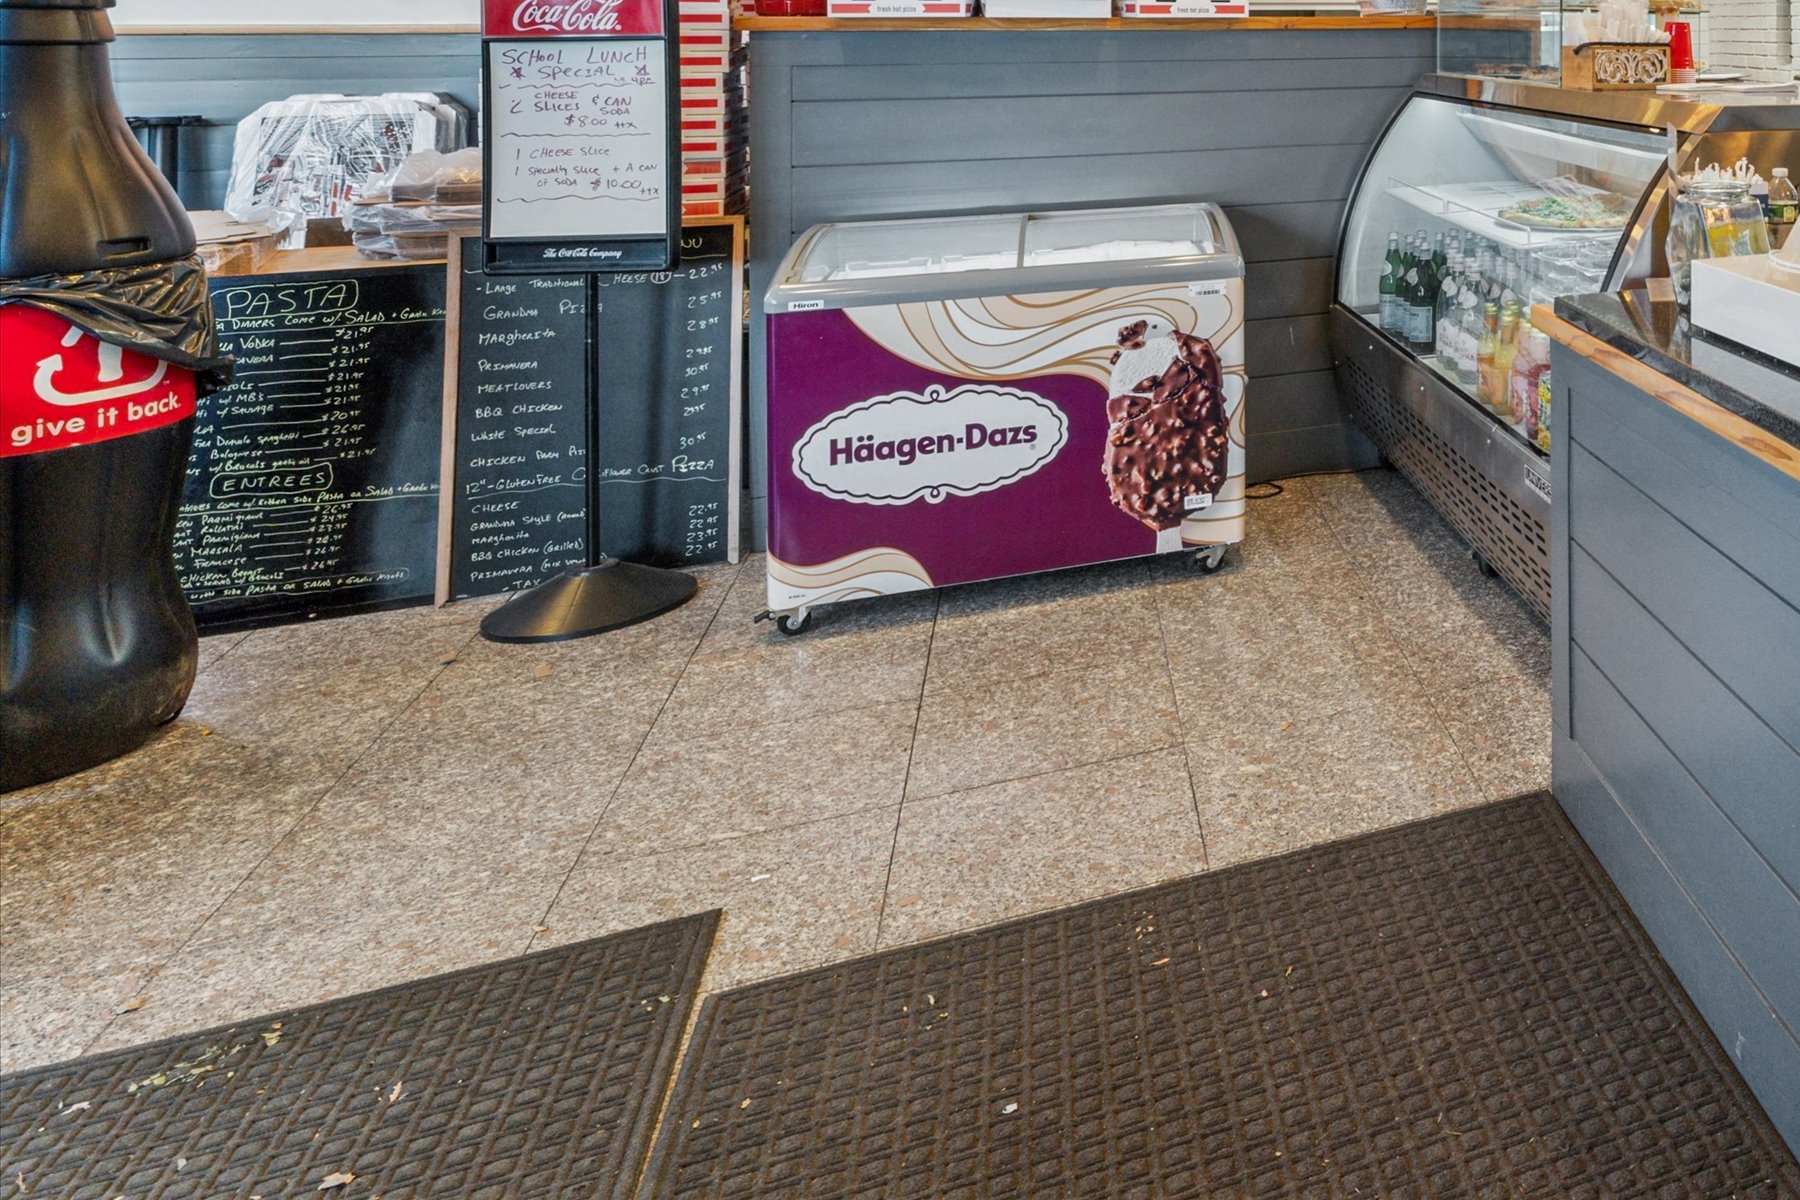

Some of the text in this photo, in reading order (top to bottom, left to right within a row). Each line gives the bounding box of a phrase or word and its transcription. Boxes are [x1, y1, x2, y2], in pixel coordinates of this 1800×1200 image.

[587, 46, 647, 64] LUNCH
[535, 91, 632, 105] CHEESE CAN
[529, 148, 574, 159] CHEESE
[227, 284, 347, 319] PASTA
[475, 407, 503, 419] BBQ
[11, 417, 86, 447] give
[97, 407, 118, 428] it
[829, 423, 1038, 467] Häagen-Dazs
[223, 472, 327, 492] ENTREES
[471, 501, 519, 514] CHEESE
